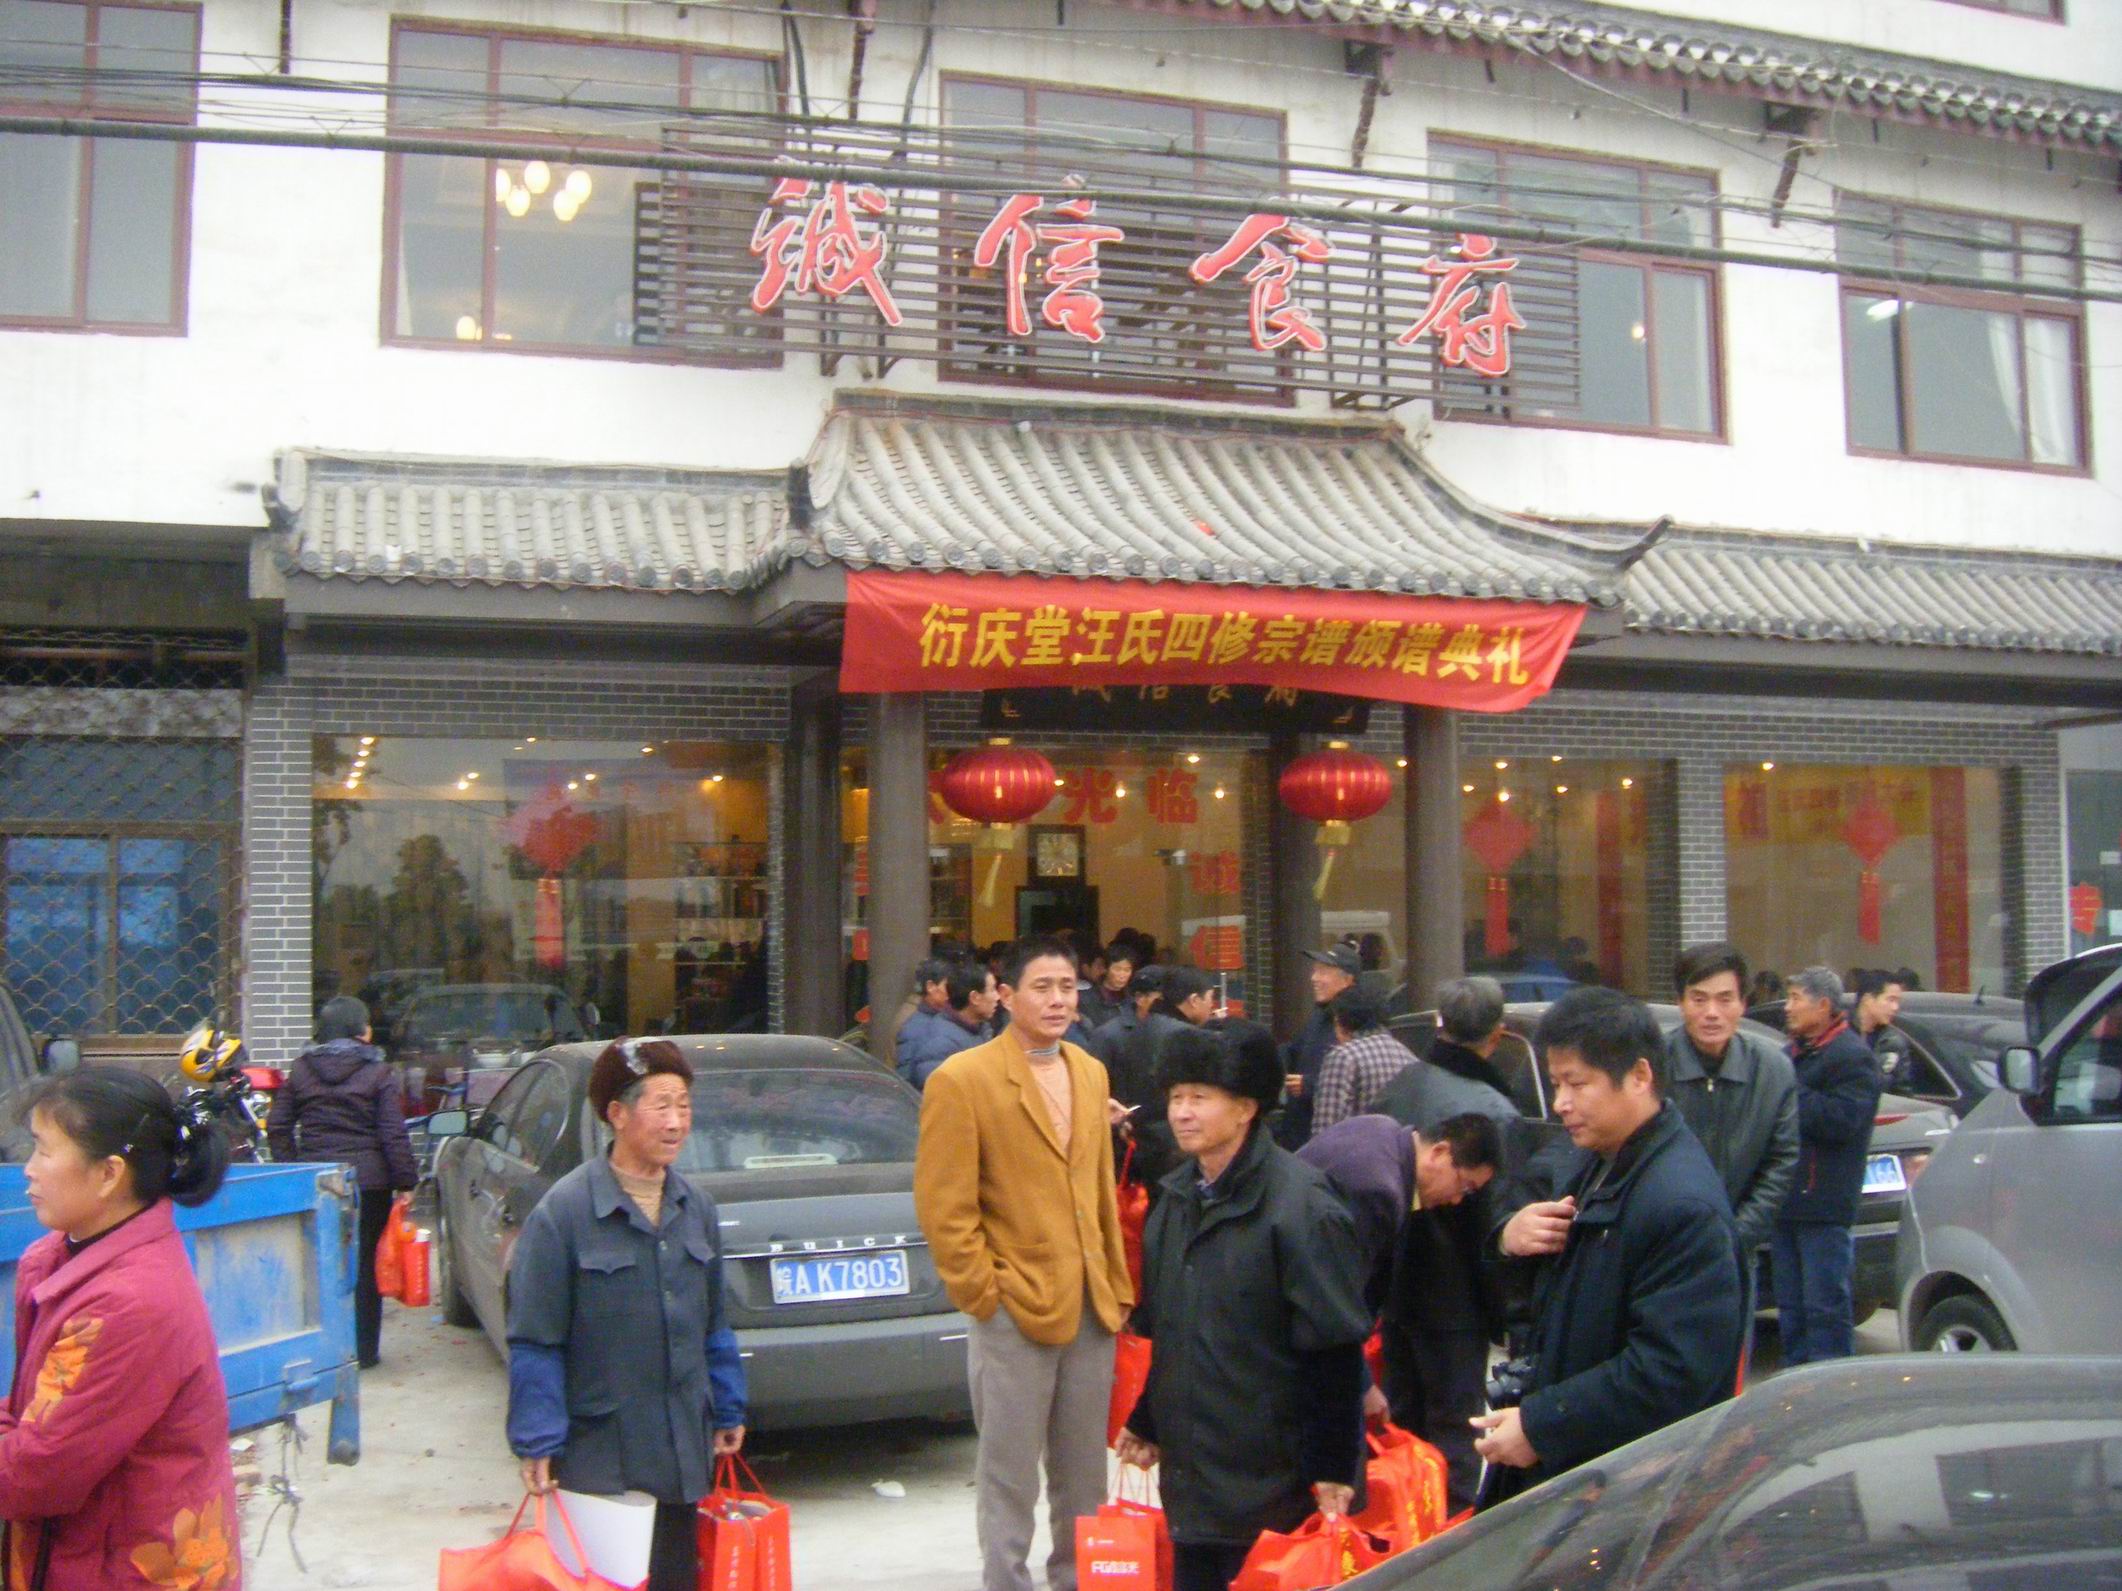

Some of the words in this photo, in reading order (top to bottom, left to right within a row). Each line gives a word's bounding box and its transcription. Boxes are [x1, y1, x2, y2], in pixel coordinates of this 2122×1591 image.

[919, 602, 1530, 685] 衍庆堂汪氏四修宗谱颁谱典礼
[770, 1235, 906, 1252] BUICK
